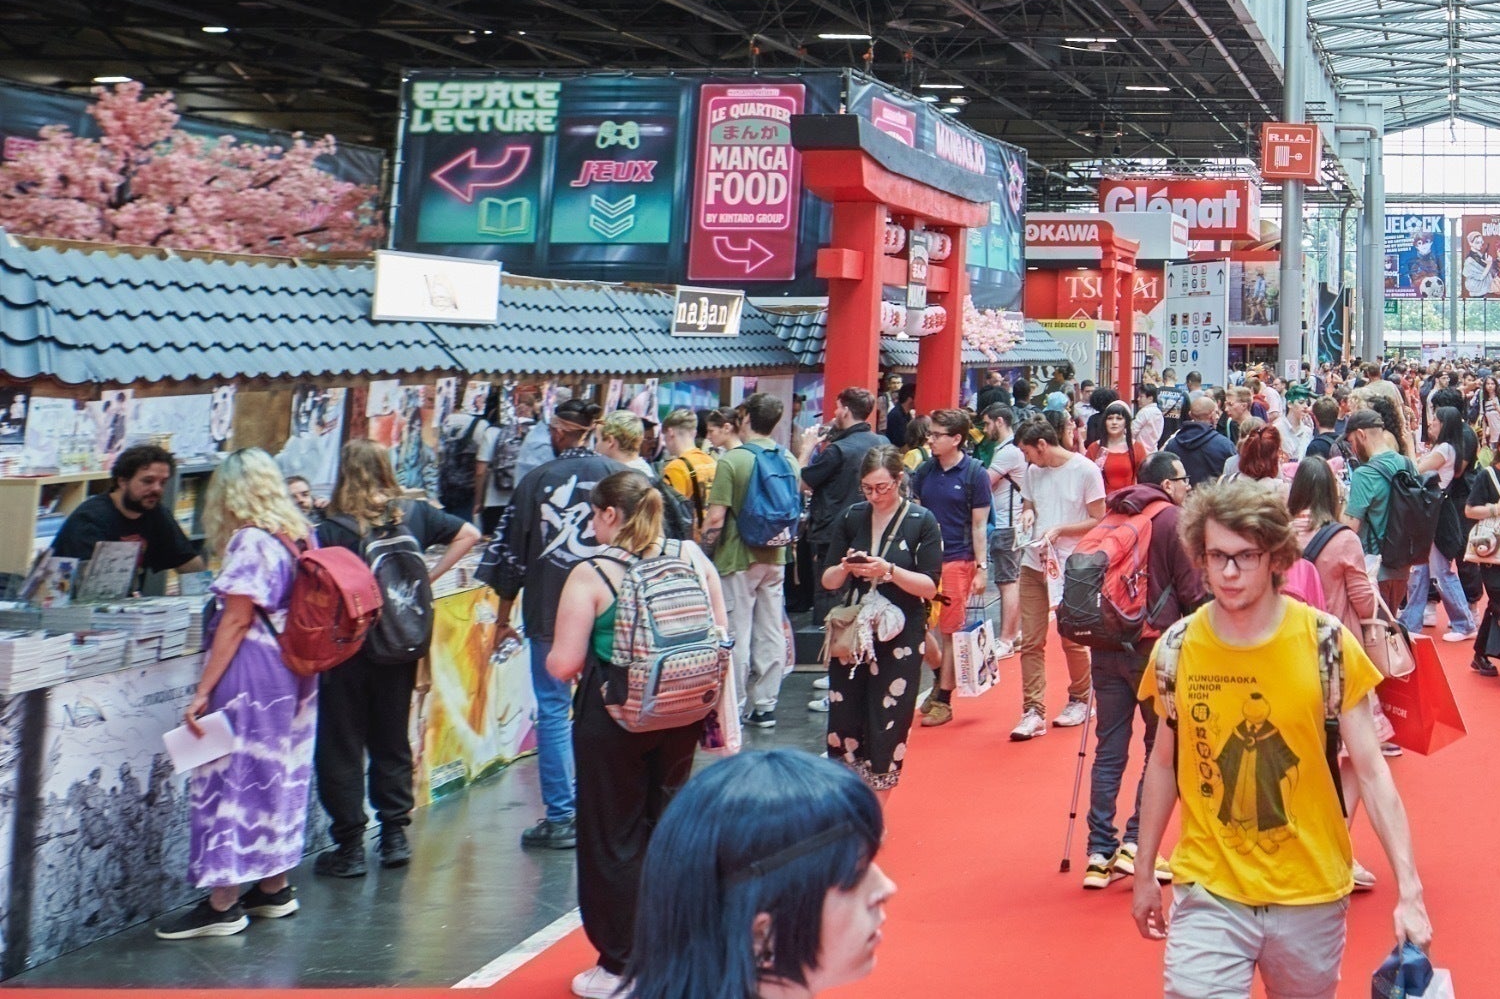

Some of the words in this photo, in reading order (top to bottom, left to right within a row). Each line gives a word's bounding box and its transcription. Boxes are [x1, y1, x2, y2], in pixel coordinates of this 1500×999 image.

[411, 81, 562, 109] ESPACE
[409, 108, 558, 133] LECTURE
[711, 106, 728, 124] LE
[729, 102, 792, 124] QUARTIER
[1268, 133, 1312, 144] R.I.A.
[709, 146, 788, 171] MANGA
[569, 161, 658, 187] JEUX
[705, 172, 788, 205] FOOD
[706, 214, 718, 223] BY
[756, 214, 784, 223] GROUP
[1104, 186, 1241, 229] Glénat
[1066, 276, 1159, 300] TSAI
[1188, 675, 1257, 684] KUNUGIGAOKA
[1188, 683, 1221, 692] JUNIOR
[1188, 692, 1209, 700] HIGH
